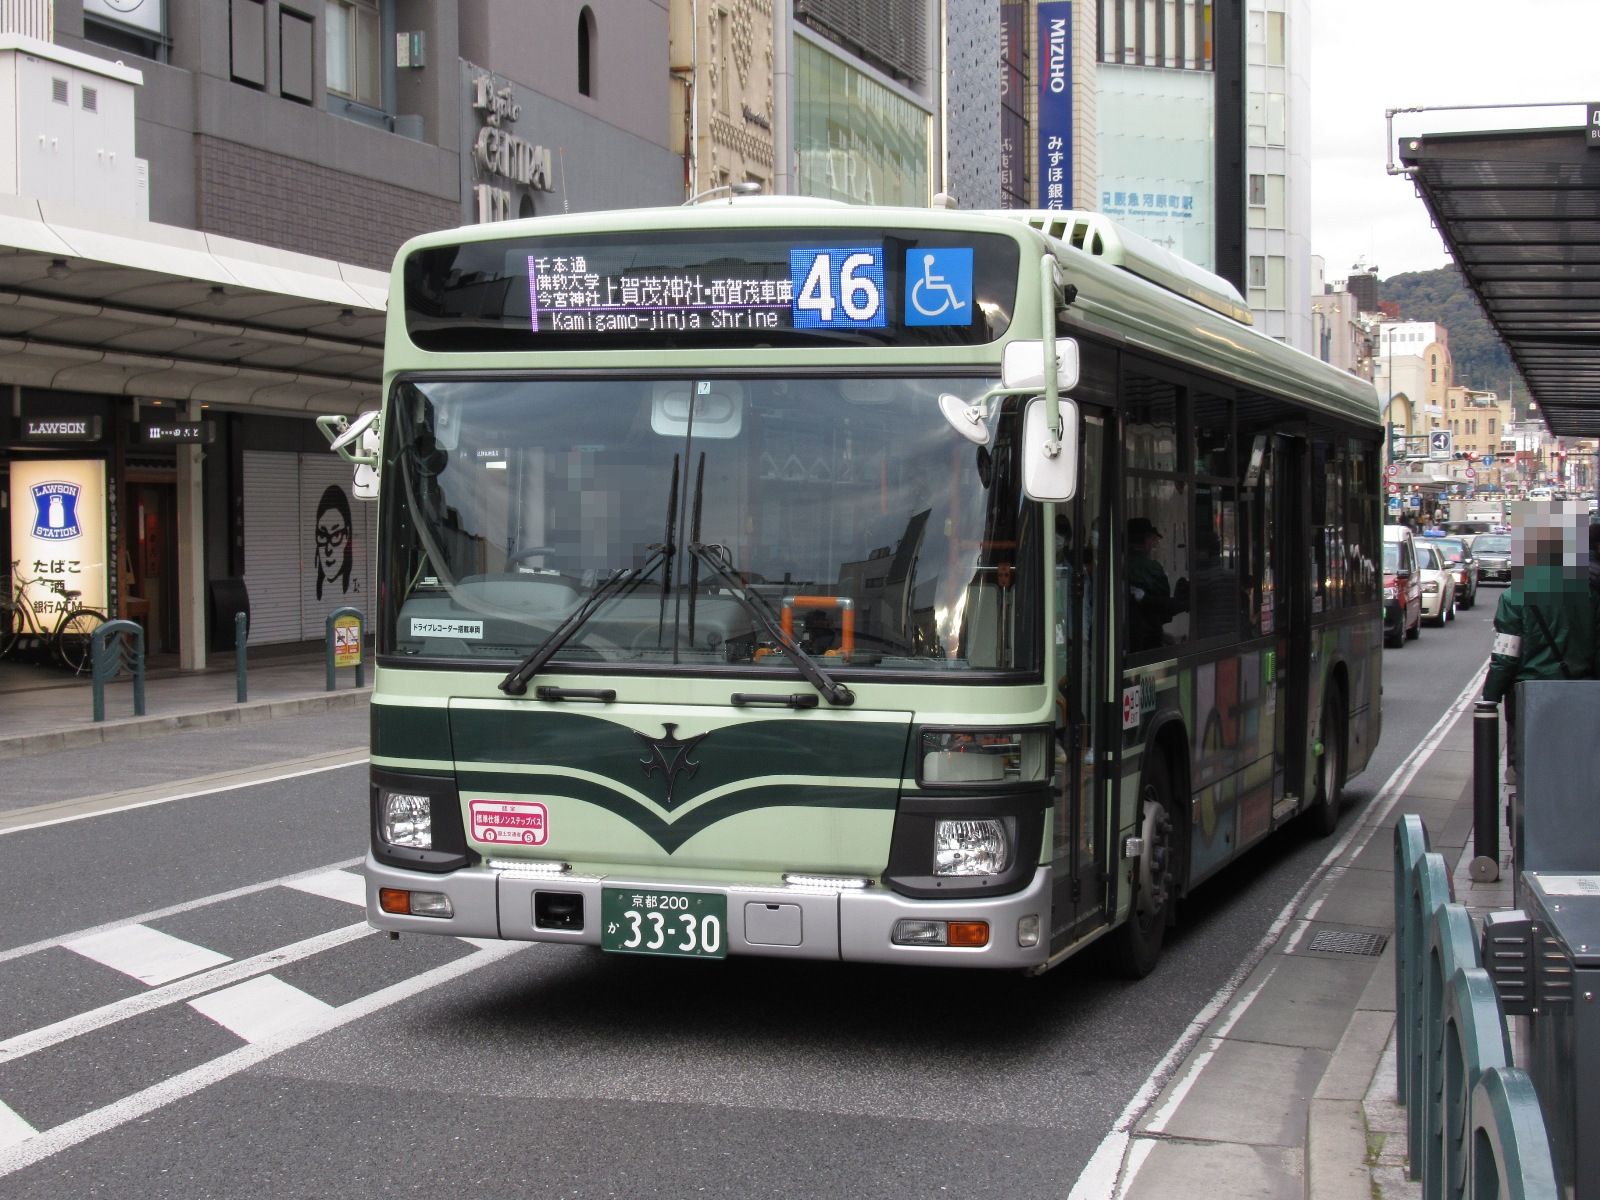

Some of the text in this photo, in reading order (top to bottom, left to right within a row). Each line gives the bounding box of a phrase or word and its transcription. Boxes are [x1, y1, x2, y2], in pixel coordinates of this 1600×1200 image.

[1051, 19, 1065, 93] MIZUHO
[1048, 136, 1063, 210] みずほ銀行
[535, 256, 586, 273] 千本通
[798, 253, 879, 321] 46
[537, 291, 600, 307] 今宮神社
[552, 309, 778, 332] Kamigamo-jinja Shrine
[29, 423, 86, 434] LAWSON
[34, 484, 77, 497] LAWSON
[36, 525, 77, 538] STATION
[33, 560, 81, 573] たばこ
[50, 580, 65, 593] 酒
[607, 910, 720, 953] か 33-30
